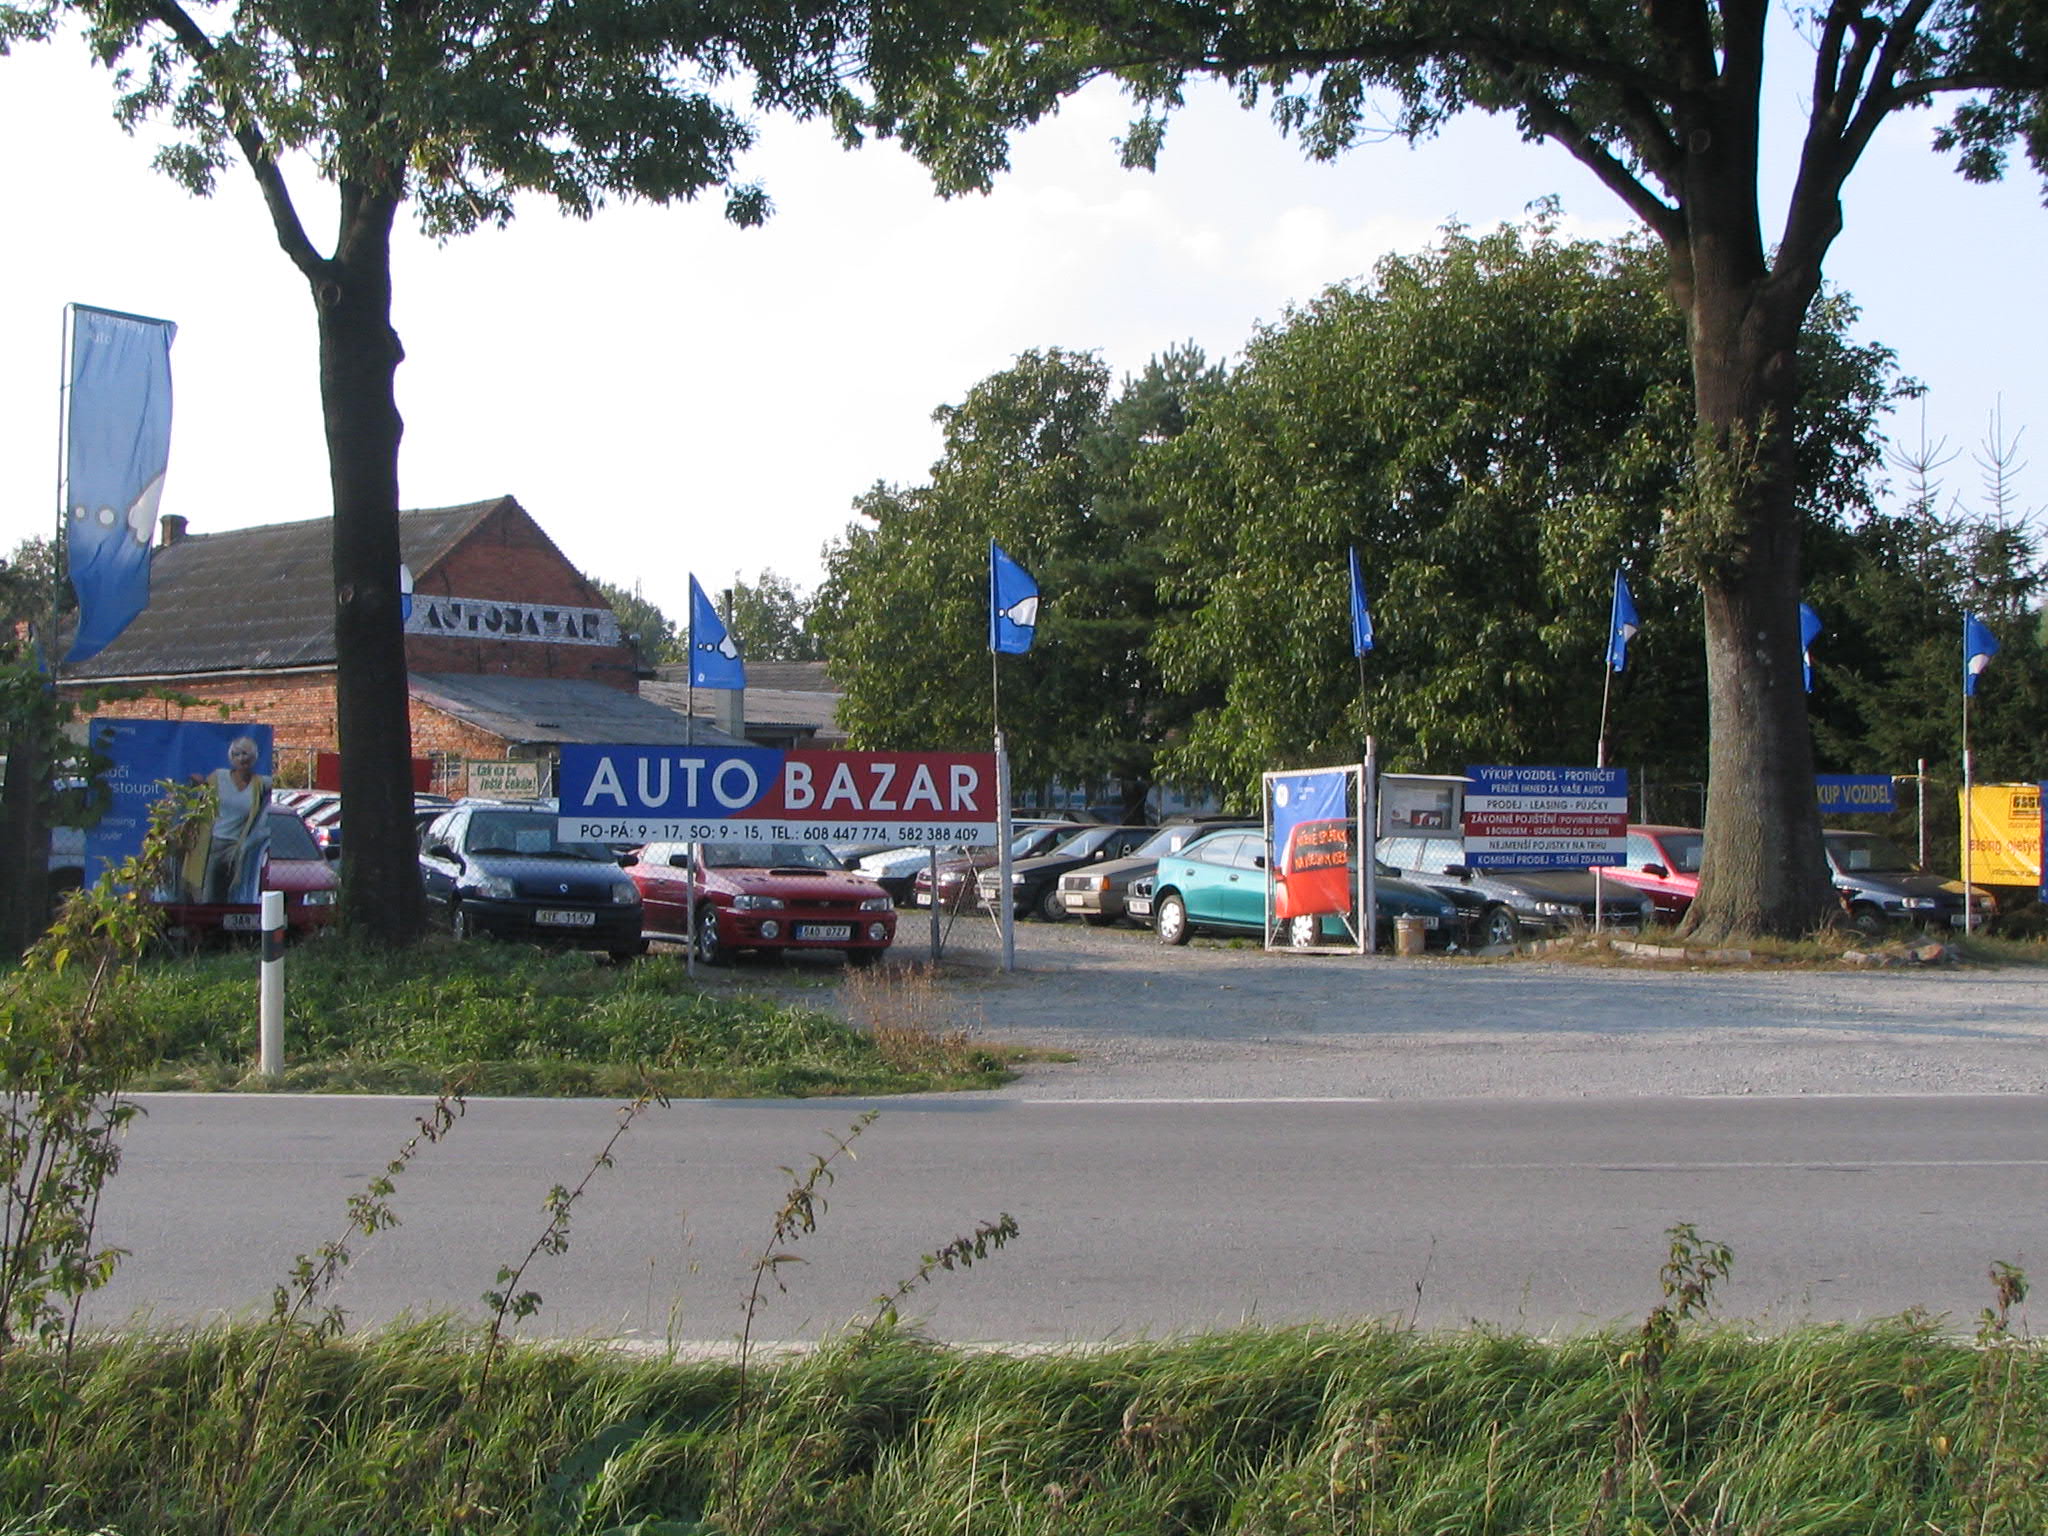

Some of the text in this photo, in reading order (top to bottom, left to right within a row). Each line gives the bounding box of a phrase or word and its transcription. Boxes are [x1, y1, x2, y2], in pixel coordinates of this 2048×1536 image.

[426, 602, 600, 639] AUTOBAZAR
[1480, 767, 1514, 780] VÝKUP
[1516, 769, 1557, 781] VOZIDEL
[582, 756, 979, 812] AUTO BAZAR
[1548, 784, 1558, 794] ZA
[1561, 782, 1581, 794] VAŠE
[1583, 785, 1605, 794] AUTO
[1816, 784, 1891, 804] KUP VOZIDEL
[1486, 799, 1522, 810] PRODEJ
[1530, 800, 1567, 810] LEASING
[580, 820, 634, 839] PO-PÁ:
[638, 824, 647, 839] 9
[664, 824, 683, 841] 17,
[690, 825, 715, 839] SO:
[719, 825, 728, 839] 9
[744, 825, 763, 841] 15,
[771, 826, 799, 840] TEL.:
[803, 827, 829, 841] 608
[832, 827, 858, 841] 447
[862, 827, 890, 843] 774,
[898, 827, 922, 841] 582
[927, 828, 951, 841] 388
[954, 828, 979, 842] 409
[1488, 839, 1531, 850] NEJMENŠÍ
[1572, 841, 1585, 850] NA
[1477, 854, 1517, 865] KOMISNÍ
[1516, 855, 1550, 865] PRODEJ
[1580, 856, 1616, 865] ZDARMA
